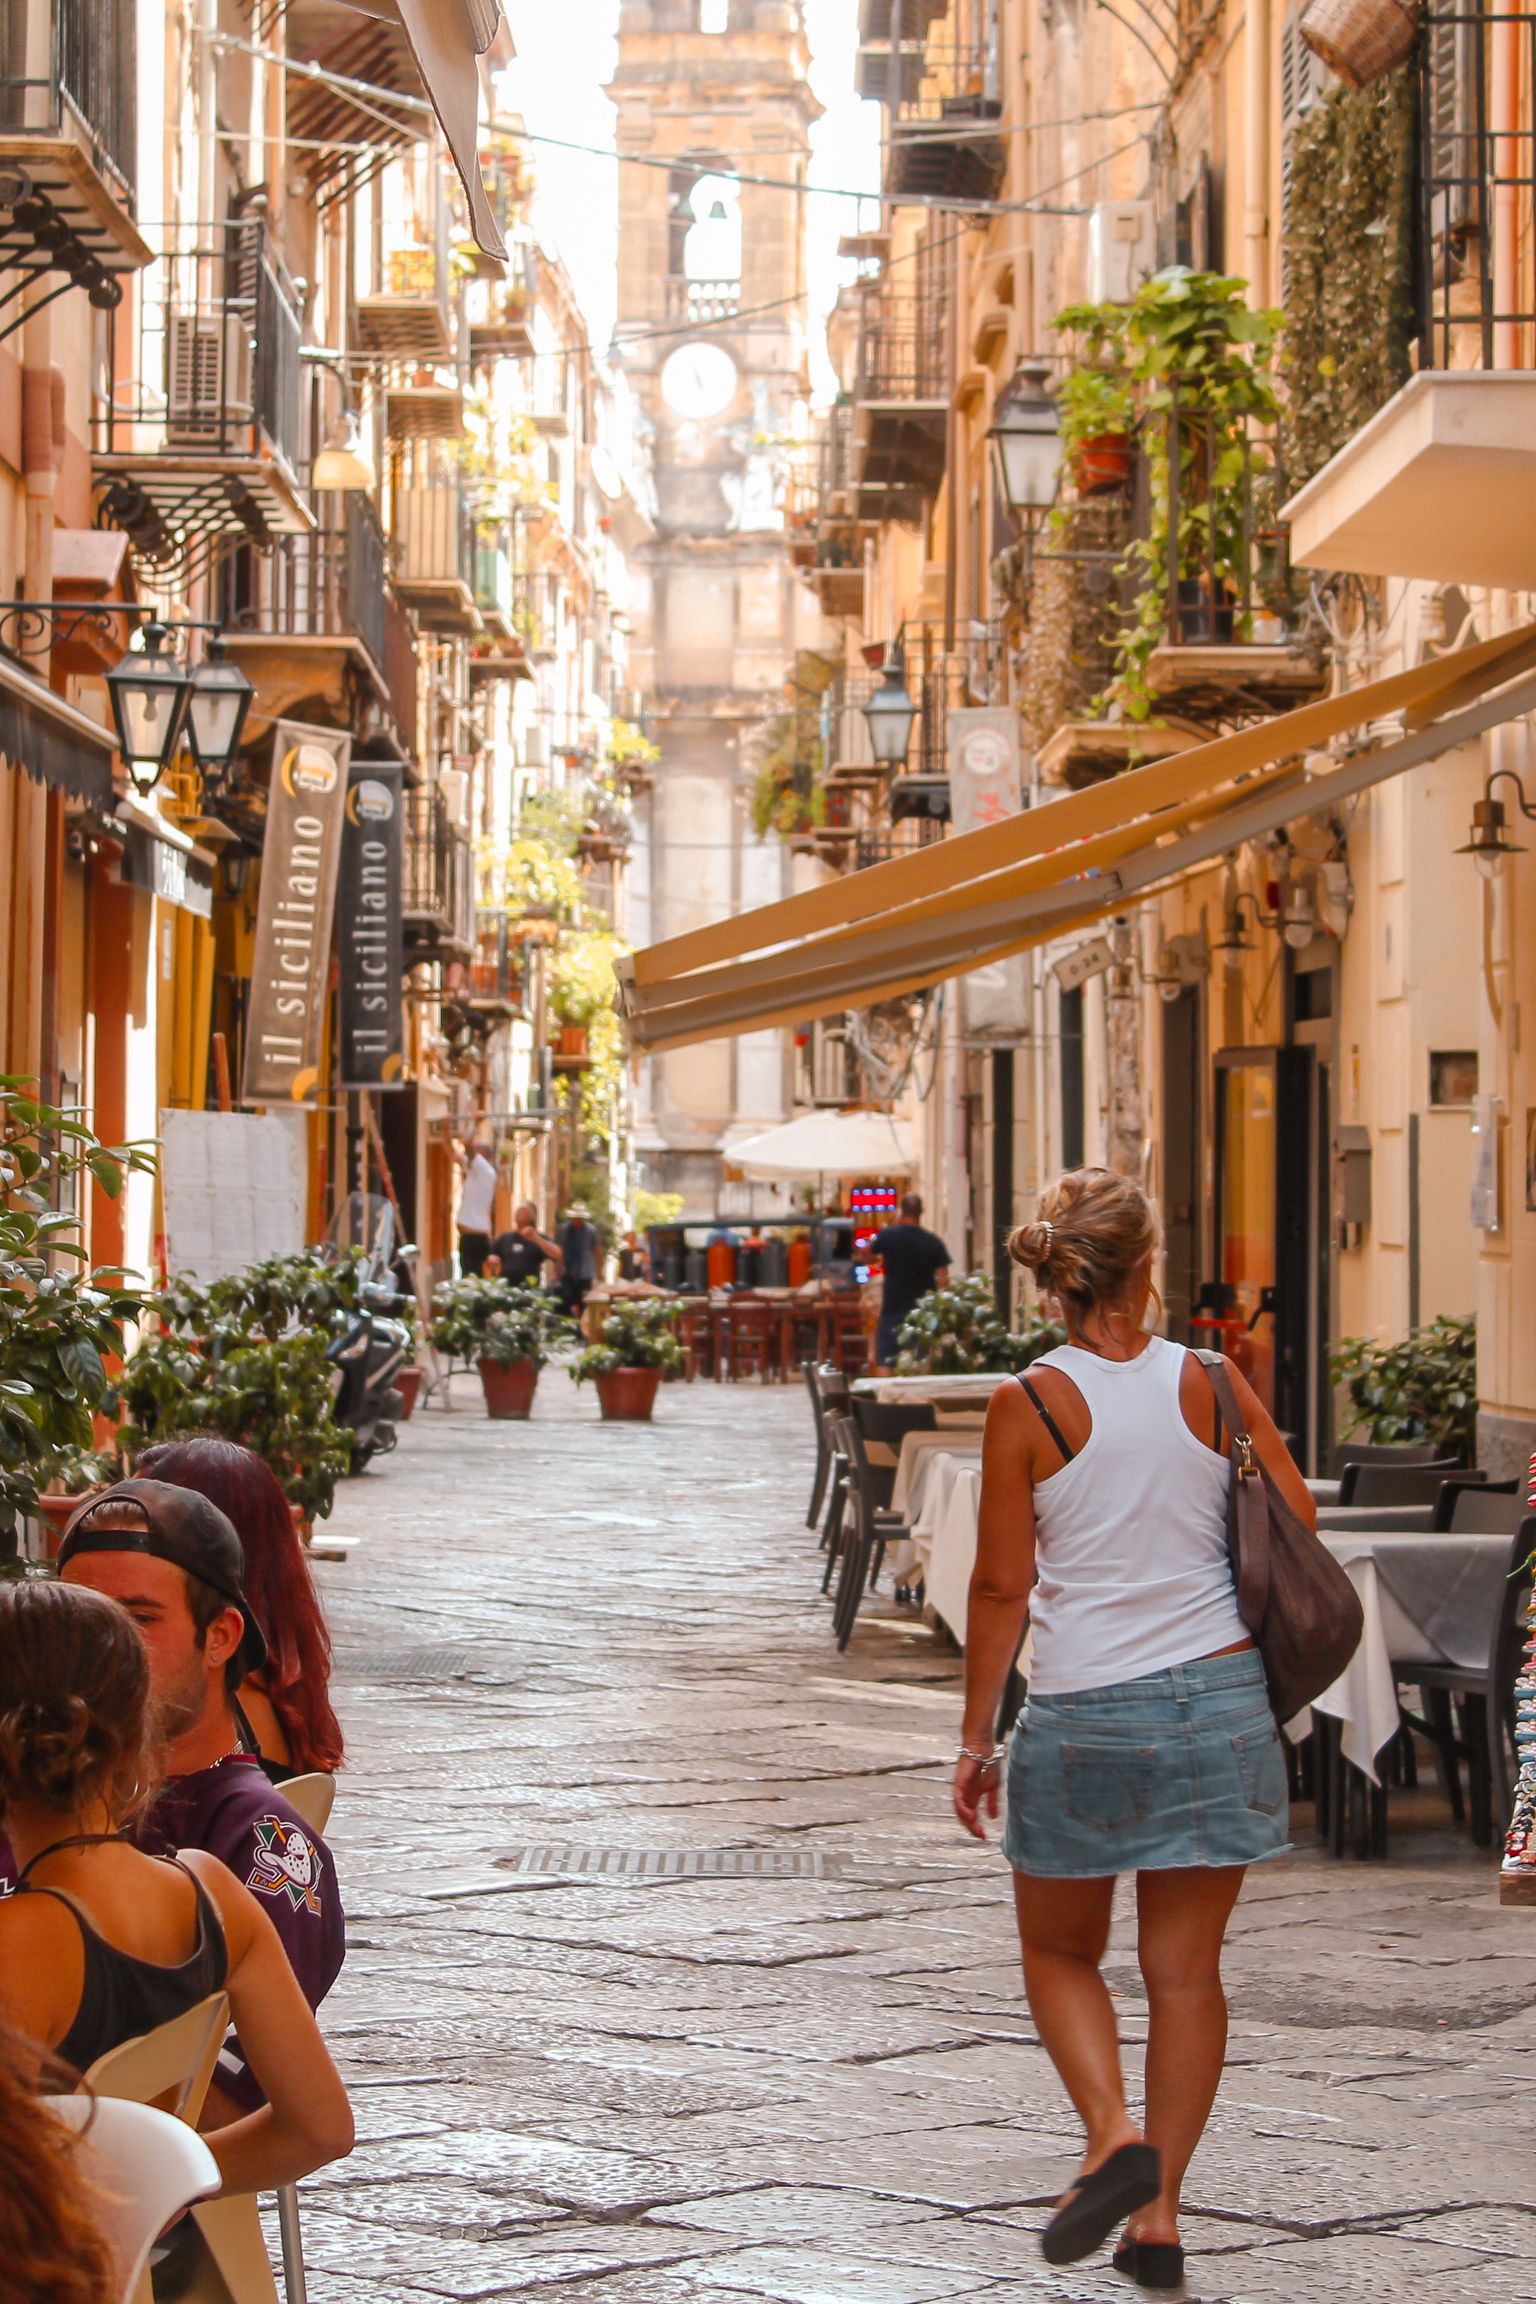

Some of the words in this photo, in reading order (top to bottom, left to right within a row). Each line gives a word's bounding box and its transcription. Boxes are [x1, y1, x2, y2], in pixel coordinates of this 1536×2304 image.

[270, 815, 324, 1017] siciliano
[352, 840, 388, 1011] siciliano
[261, 1034, 303, 1066] il
[352, 1029, 388, 1054] il
